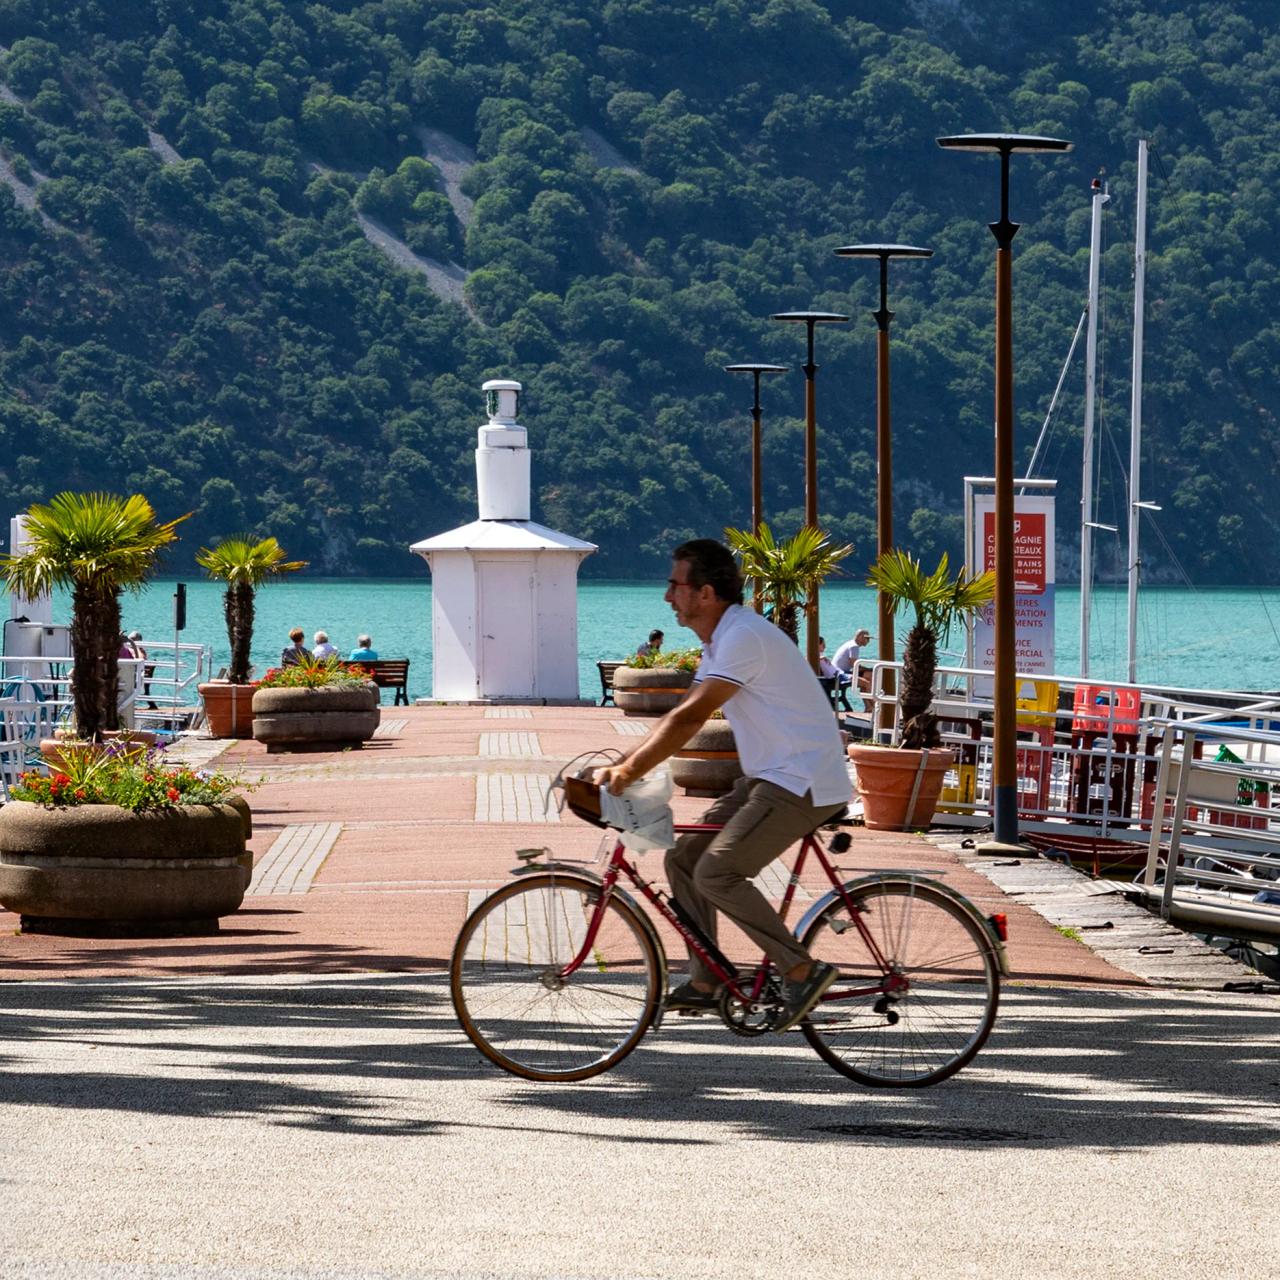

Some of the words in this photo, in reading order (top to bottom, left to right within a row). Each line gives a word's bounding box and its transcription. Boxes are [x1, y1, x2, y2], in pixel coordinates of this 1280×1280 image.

[988, 535, 1042, 544] CAGNIE
[1014, 547, 1042, 555] TEAUX
[983, 609, 1046, 617] RERATION
